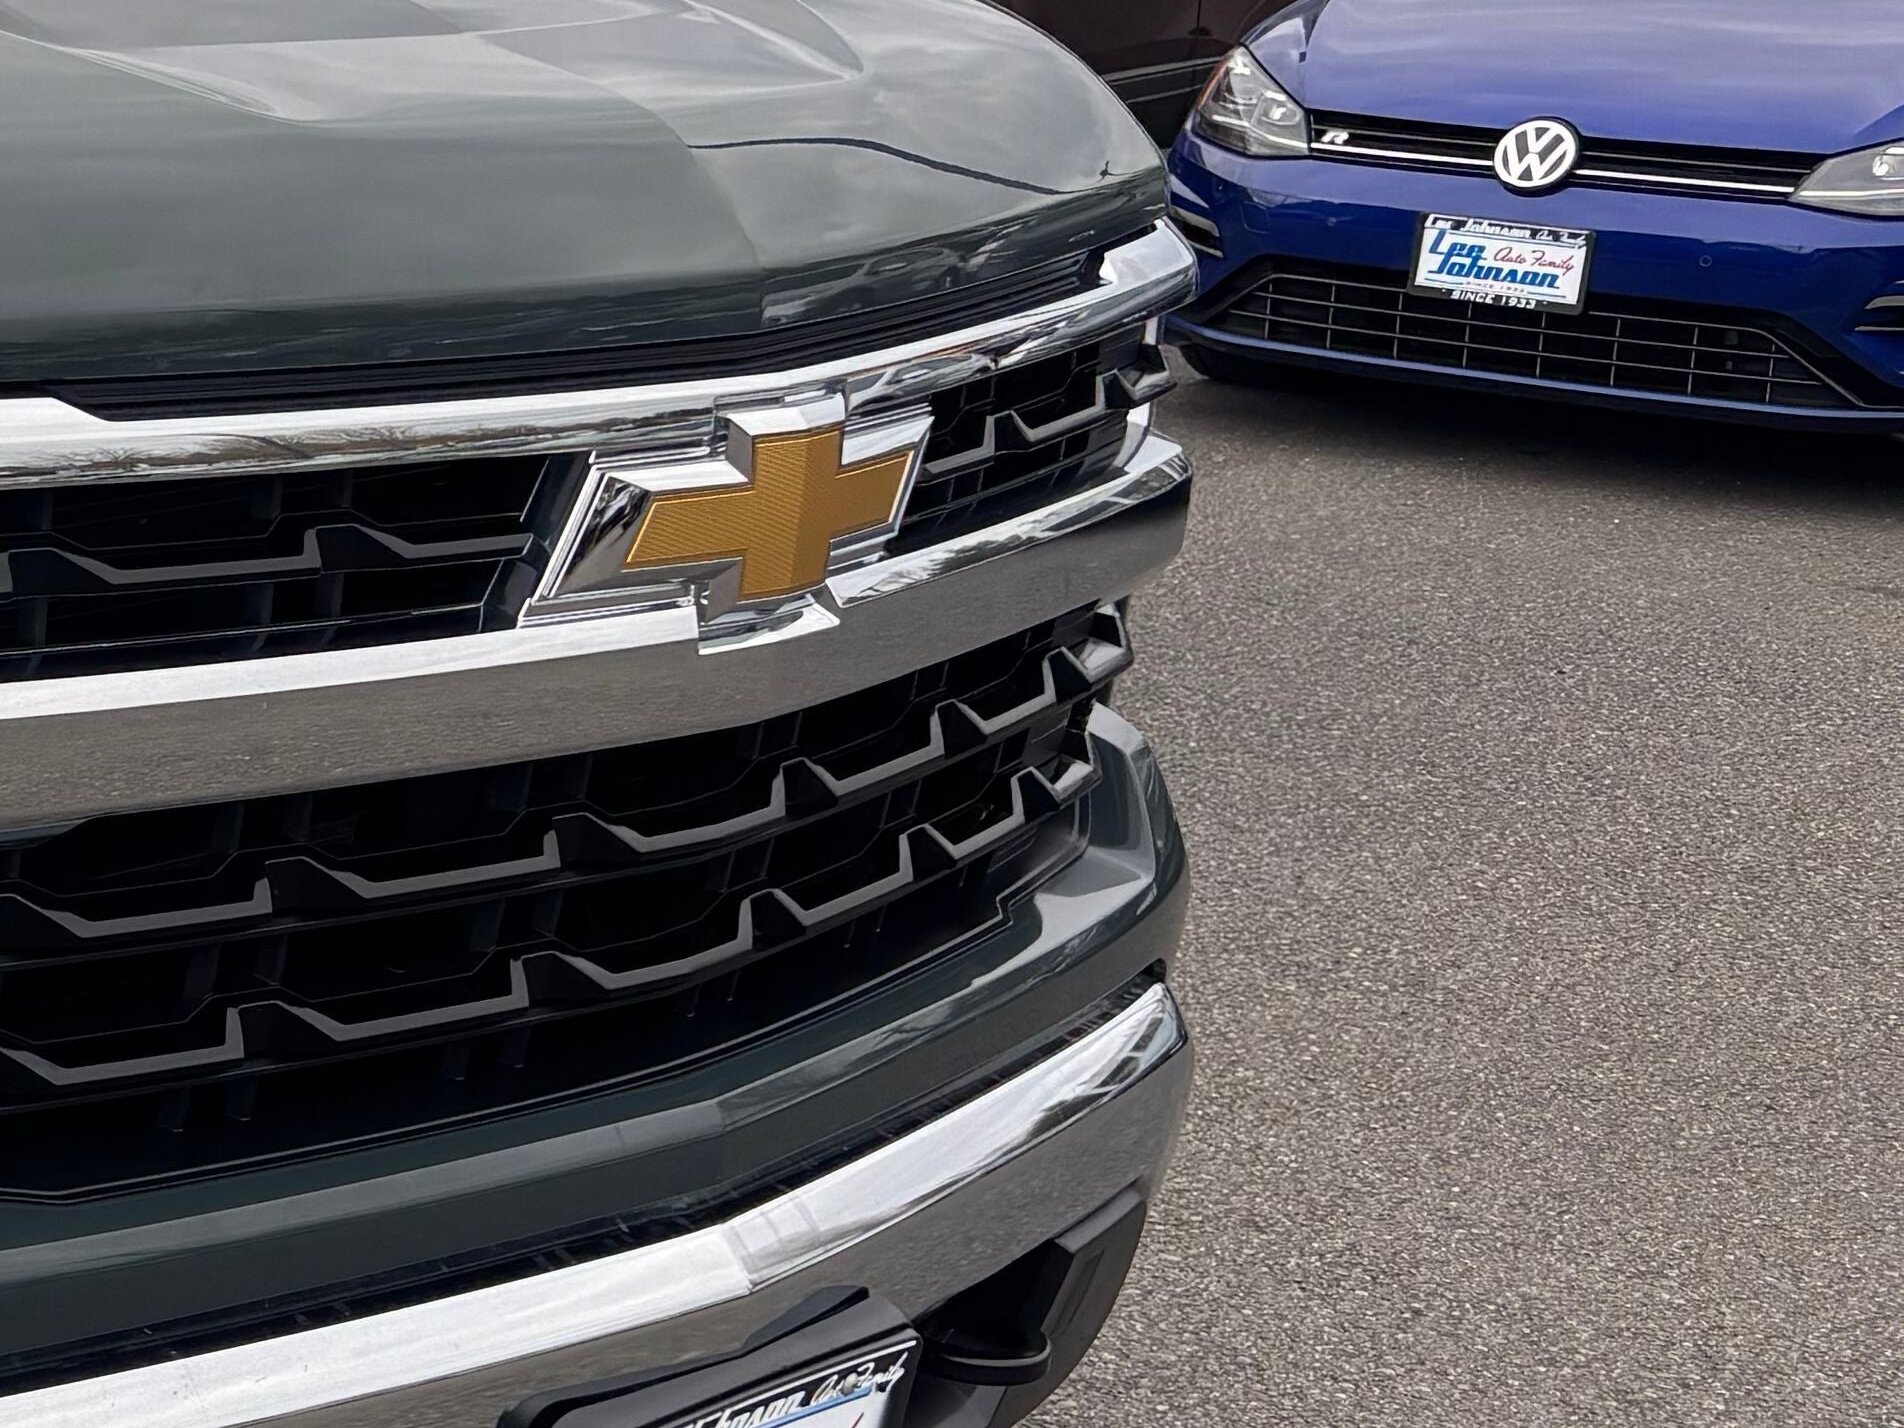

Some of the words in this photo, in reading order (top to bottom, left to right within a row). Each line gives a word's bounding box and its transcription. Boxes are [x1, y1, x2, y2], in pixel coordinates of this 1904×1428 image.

[1321, 131, 1350, 145] R
[1429, 229, 1486, 258] Lee
[1427, 247, 1560, 289] Johnson
[1493, 246, 1527, 264] Auto
[1530, 249, 1575, 277] Family
[1450, 290, 1496, 305] SINCE
[1500, 293, 1537, 310] 1933
